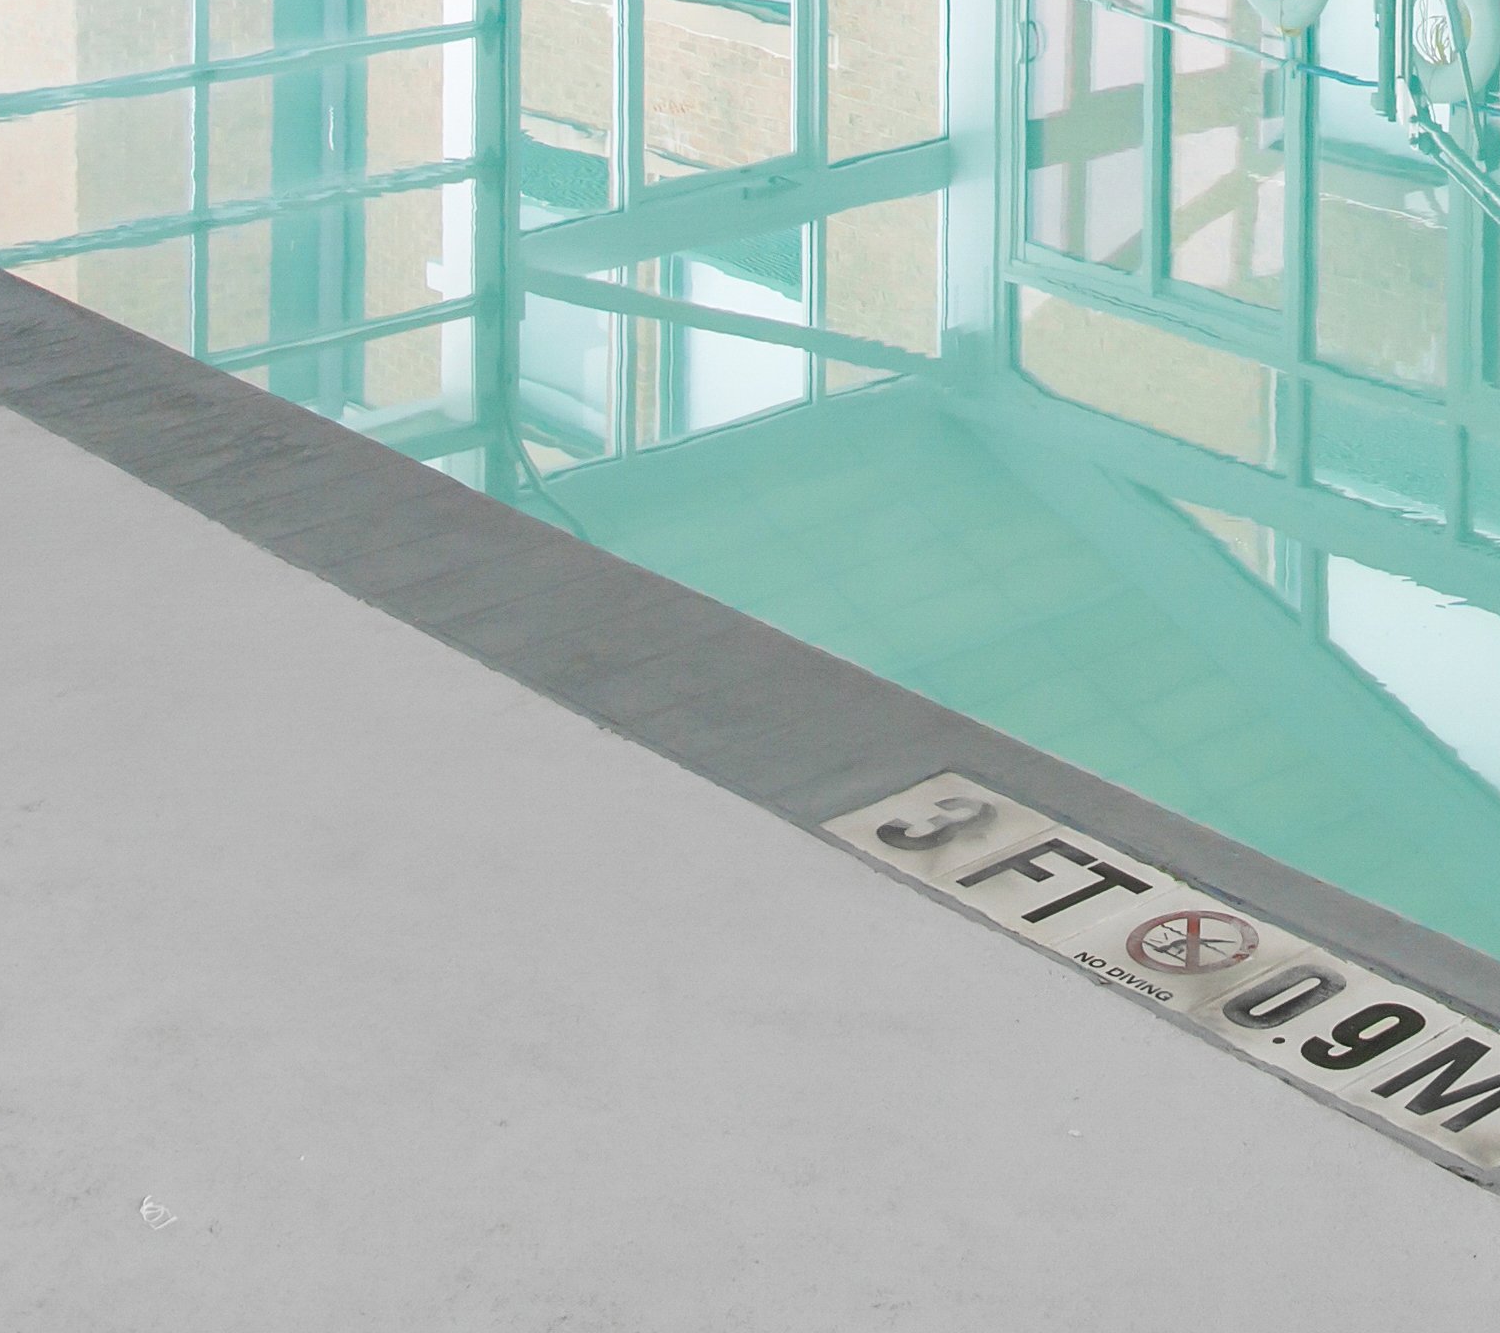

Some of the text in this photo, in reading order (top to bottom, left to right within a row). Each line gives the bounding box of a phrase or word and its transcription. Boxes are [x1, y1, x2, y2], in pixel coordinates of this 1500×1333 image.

[876, 796, 997, 852] 3
[955, 837, 1153, 924] FT
[1073, 951, 1174, 1002] NO DIVING
